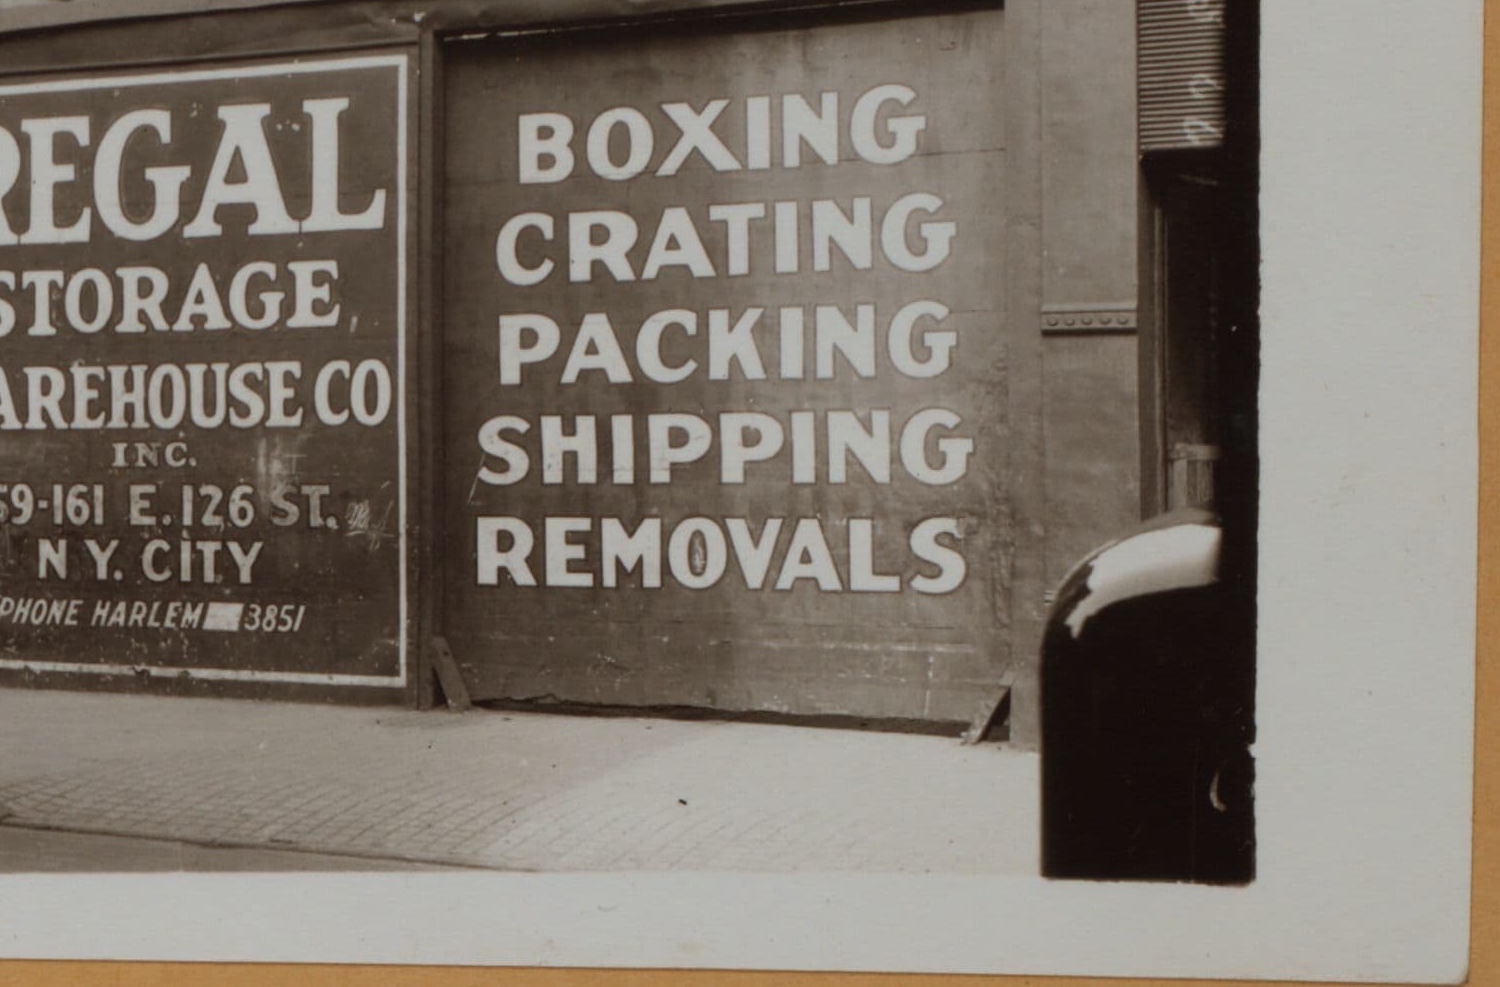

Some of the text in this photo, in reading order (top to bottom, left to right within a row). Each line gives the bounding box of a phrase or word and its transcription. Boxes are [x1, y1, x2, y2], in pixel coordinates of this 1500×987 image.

[519, 84, 926, 184] BOXING
[496, 192, 957, 285] CRATING
[499, 300, 957, 384] PACKING
[314, 358, 392, 426] CO
[112, 442, 197, 468] INC.
[478, 409, 974, 486] SHIPPING
[129, 484, 172, 526] E.
[182, 484, 255, 527] 126
[271, 484, 338, 530] ST.
[142, 538, 264, 584] CITY
[477, 516, 966, 594] REMOVALS
[0, 597, 306, 632] PHONE HARLEM 3851
